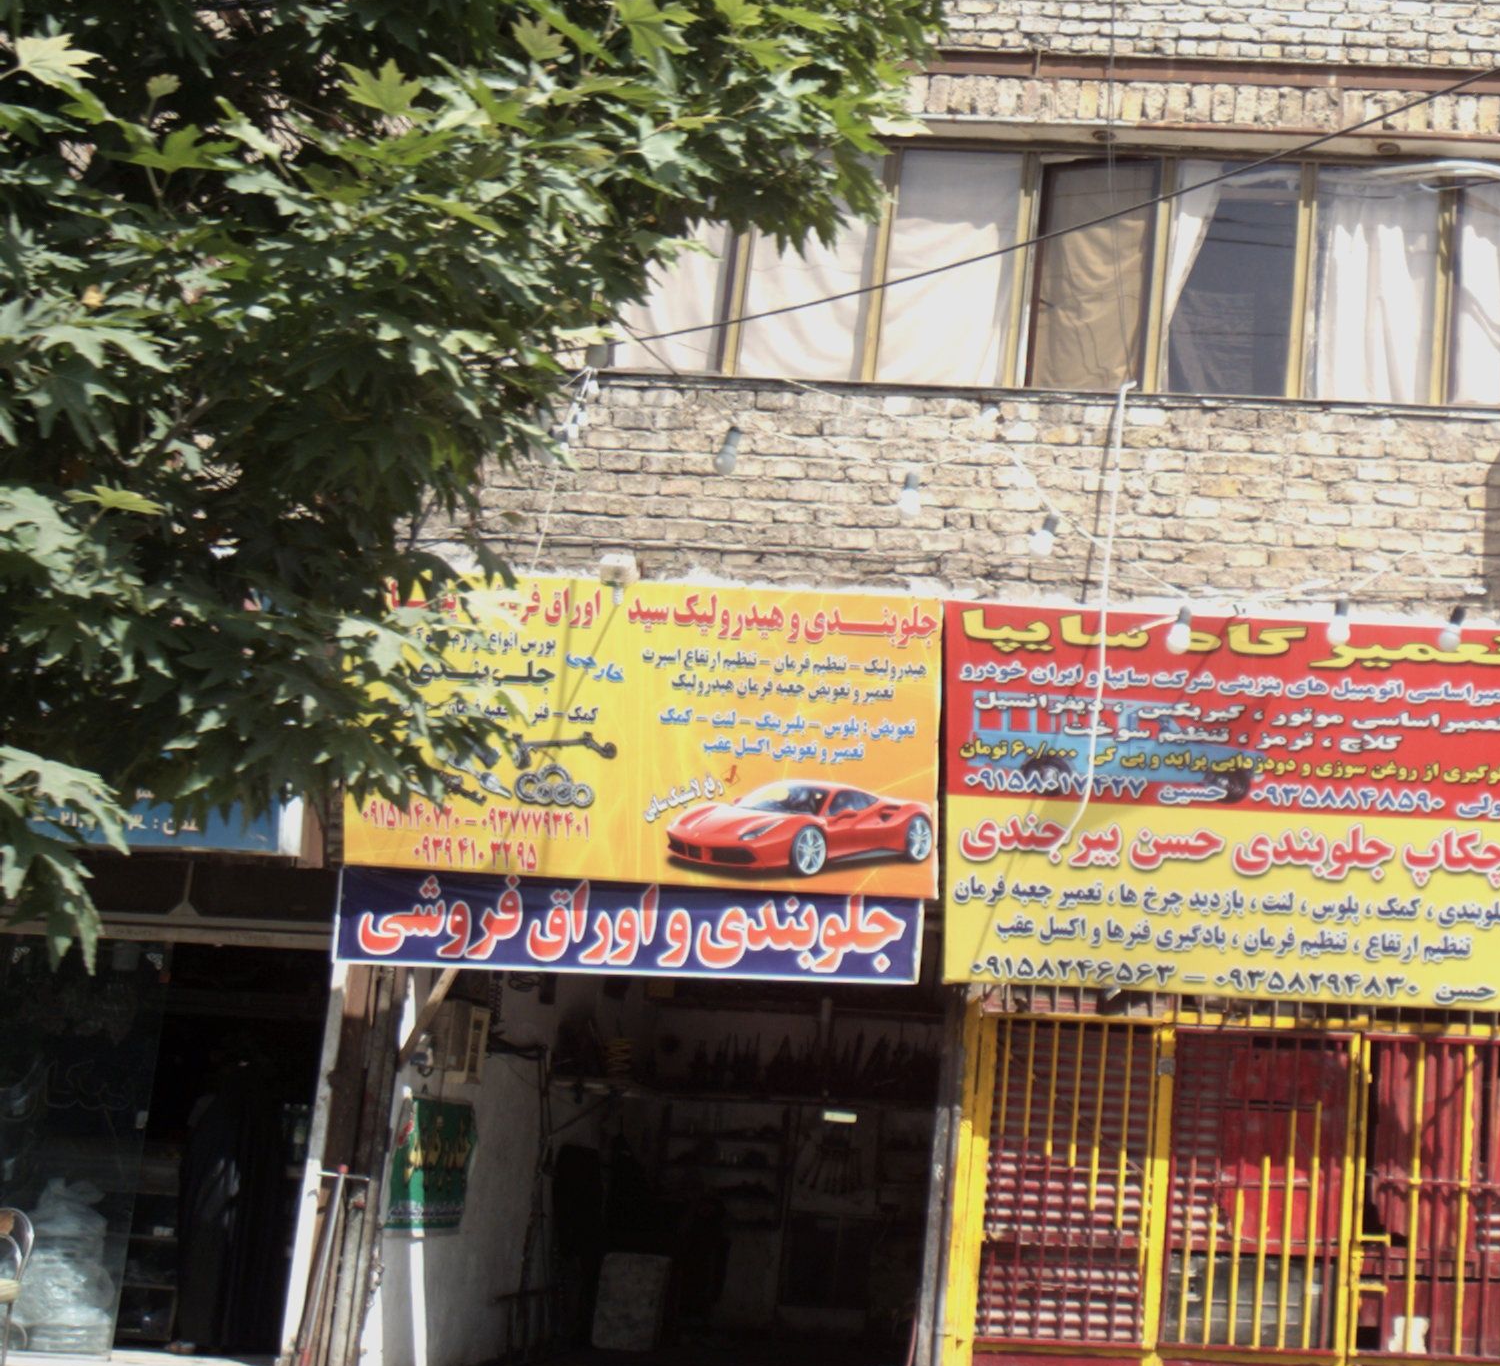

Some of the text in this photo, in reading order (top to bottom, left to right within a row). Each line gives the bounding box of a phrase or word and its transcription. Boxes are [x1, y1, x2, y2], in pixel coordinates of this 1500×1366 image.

[545, 587, 601, 627] اوراق
[627, 594, 938, 648] جلوبندی و هیدرولیک سید
[961, 608, 1150, 652] سایپا
[1087, 670, 1099, 686] و
[1150, 754, 1161, 770] و
[1158, 783, 1229, 805] حسین
[959, 812, 1123, 867] بیرجندی
[1128, 826, 1226, 869] حسن
[1232, 824, 1396, 882] جلوبندی
[953, 875, 1007, 905] فرمان
[1119, 883, 1138, 905] ها
[1261, 891, 1296, 913] لنت
[1376, 896, 1422, 919] کمک
[357, 873, 907, 974] جلوبندی و اوراق فروشی
[1091, 925, 1101, 946] و
[1243, 926, 1296, 956] فرمان
[1434, 984, 1498, 1004] حسن
